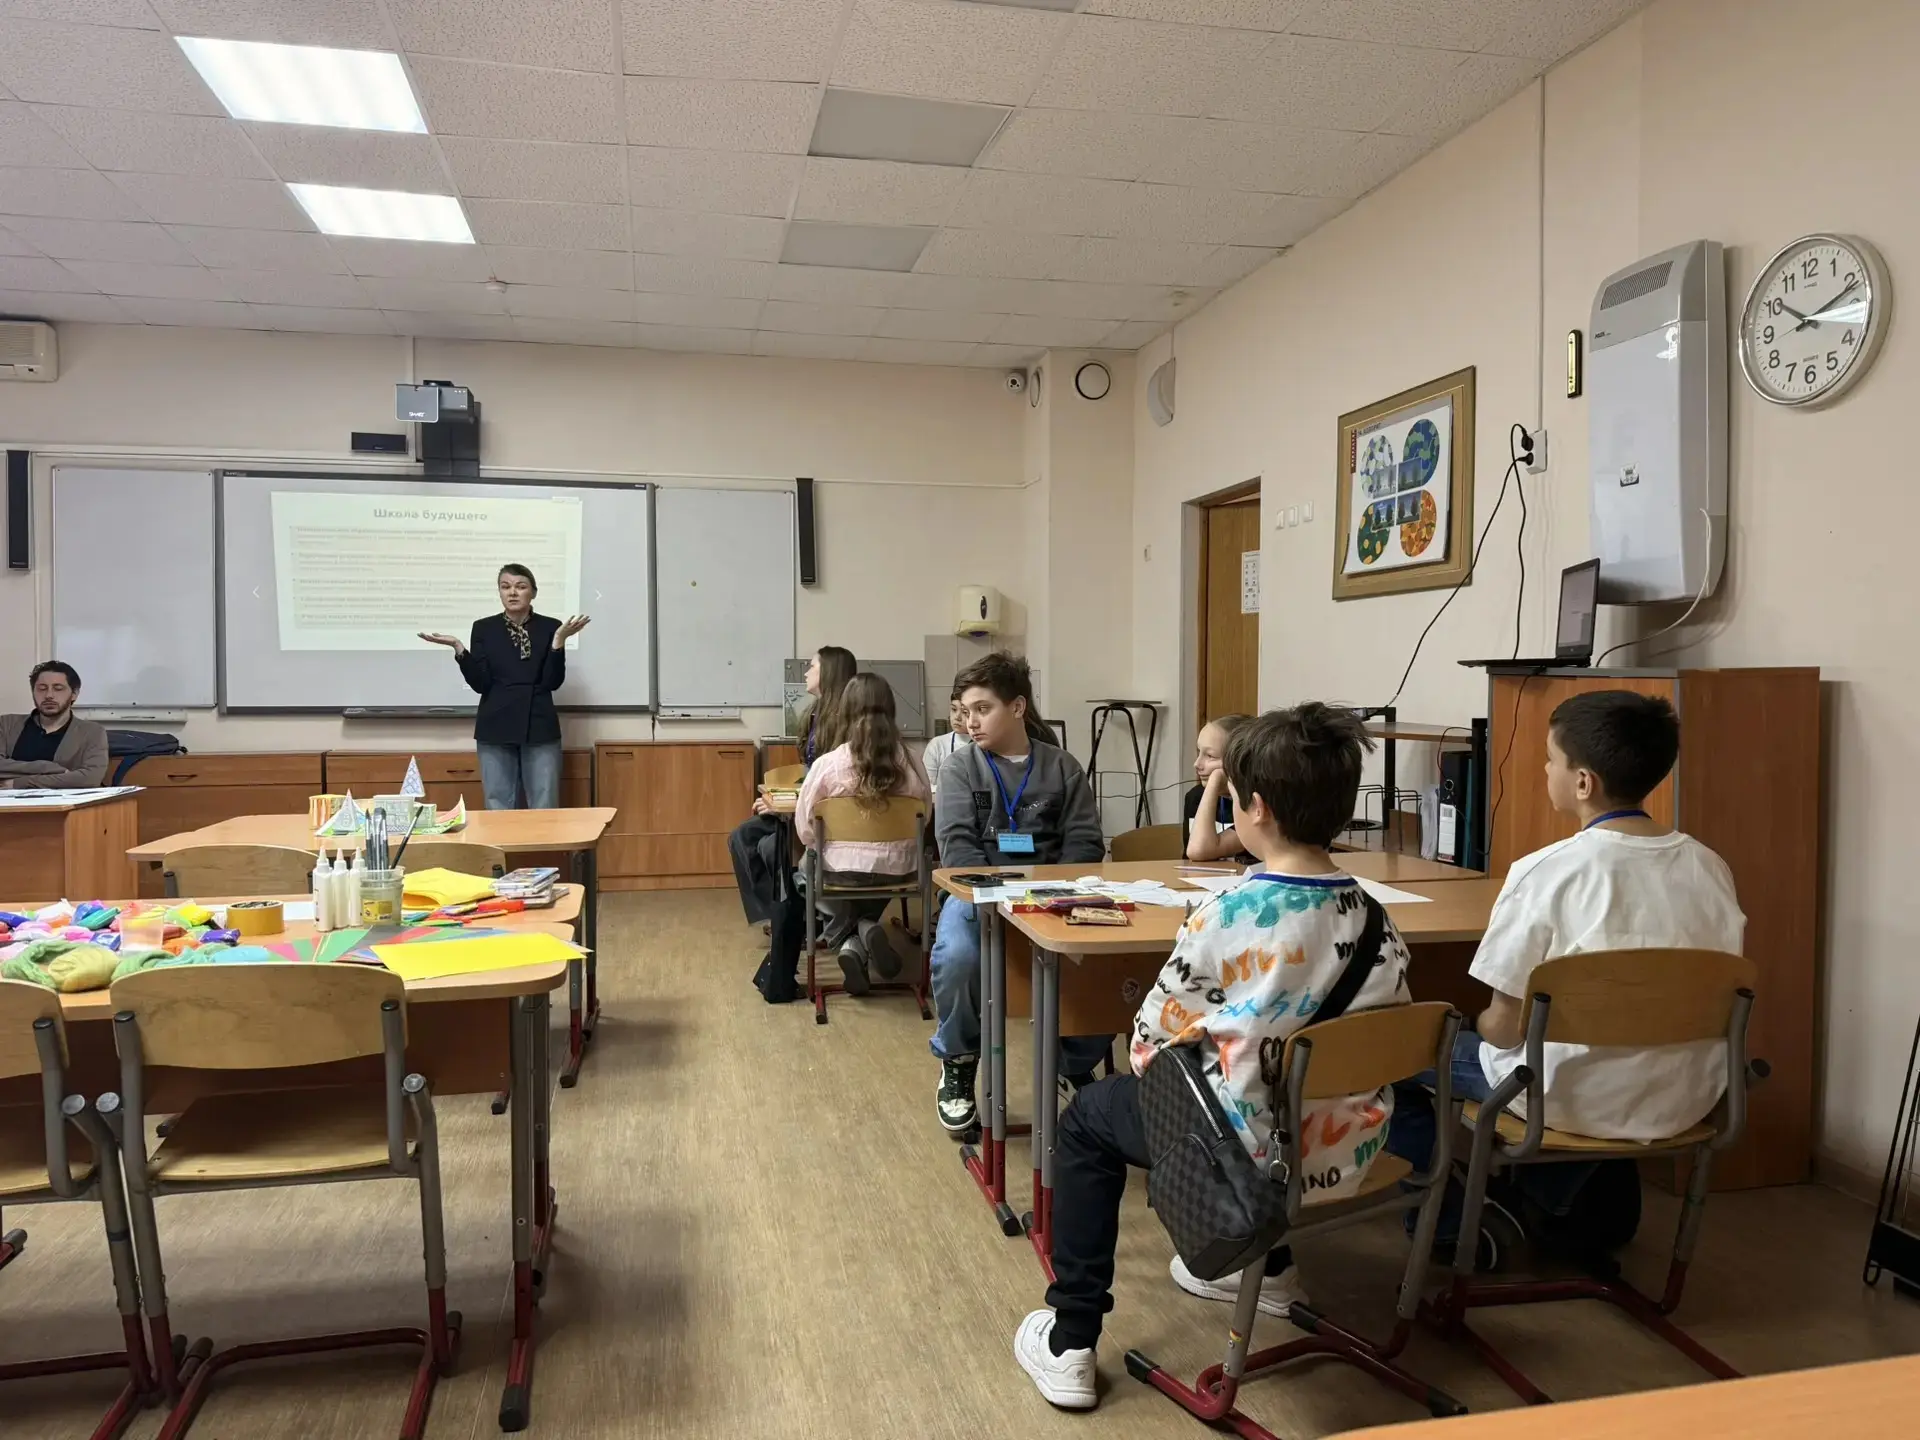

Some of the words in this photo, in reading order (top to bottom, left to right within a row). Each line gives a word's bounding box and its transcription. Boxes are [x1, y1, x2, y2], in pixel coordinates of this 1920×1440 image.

[1801, 257, 1819, 280] 12
[1829, 257, 1837, 277] 1
[1782, 273, 1796, 293] 11
[1843, 272, 1857, 291] 2
[1764, 297, 1784, 318] 10
[1763, 325, 1775, 344] 9
[1841, 329, 1855, 346] 4
[1768, 350, 1780, 369] 8
[1826, 351, 1839, 370] 5
[1785, 362, 1797, 382] 7
[1804, 364, 1817, 384] 6
[373, 508, 419, 519] Школа
[422, 509, 488, 522] будущего
